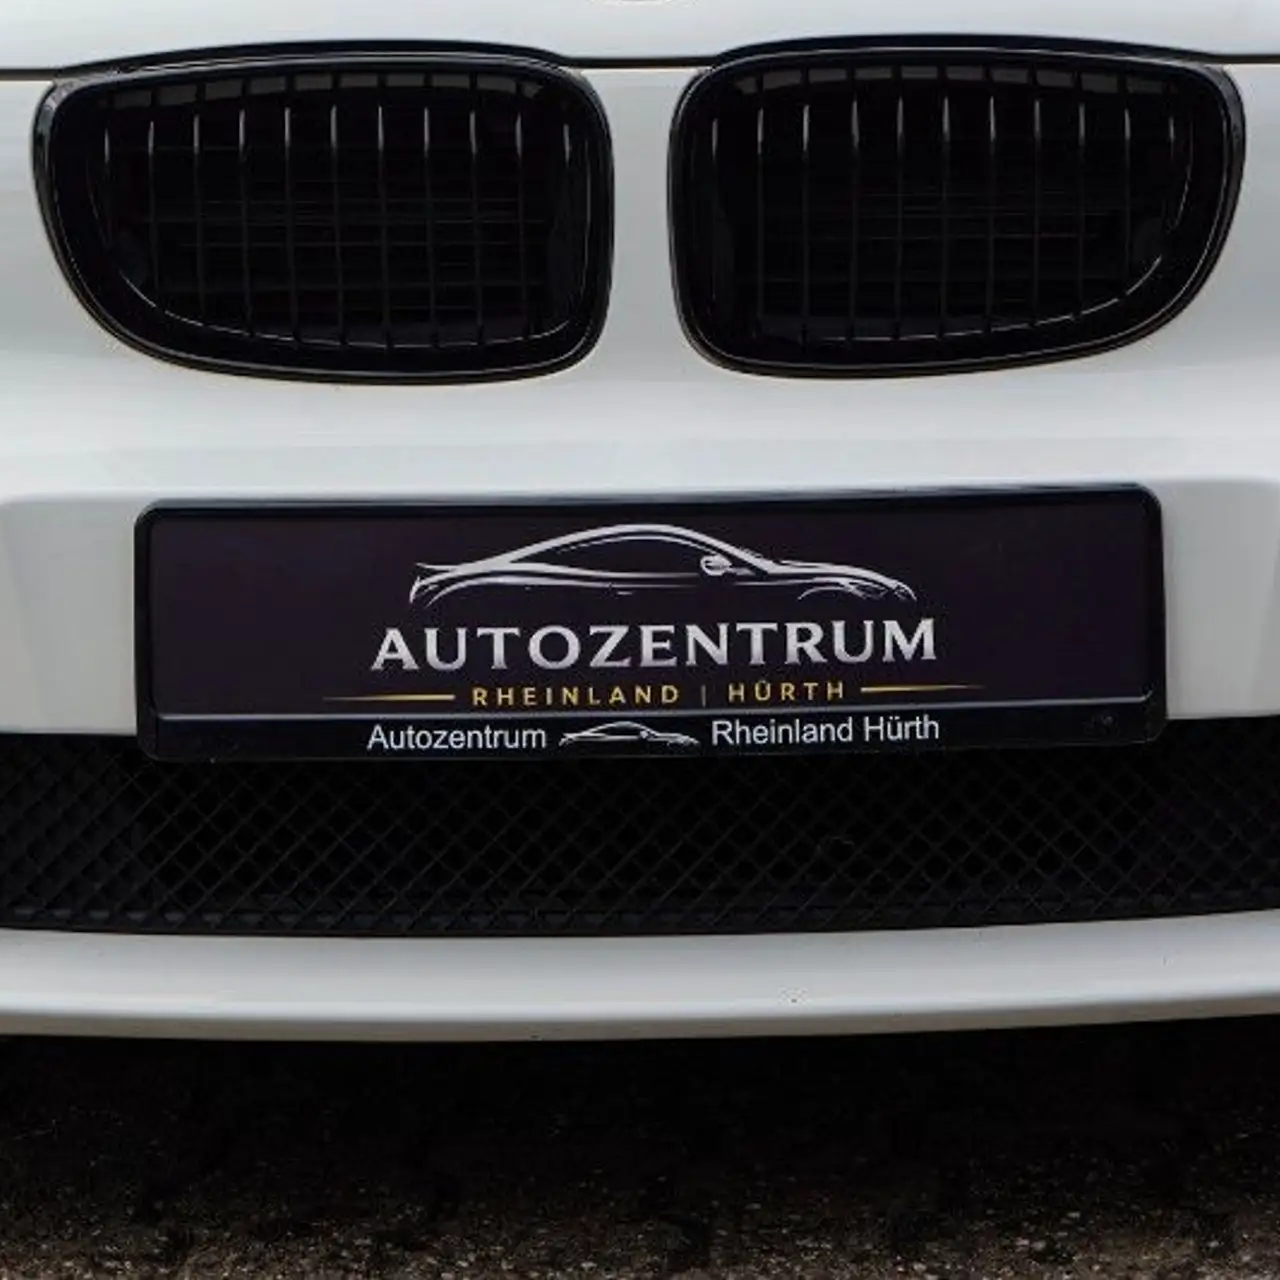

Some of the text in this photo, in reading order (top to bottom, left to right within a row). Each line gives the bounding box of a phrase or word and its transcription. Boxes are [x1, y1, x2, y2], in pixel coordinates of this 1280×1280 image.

[370, 616, 938, 671] AUTOZENTRUM
[472, 679, 846, 707] RHEINLAND HÜRTH
[366, 713, 940, 751] Autozentrum Rheinland Hürth
